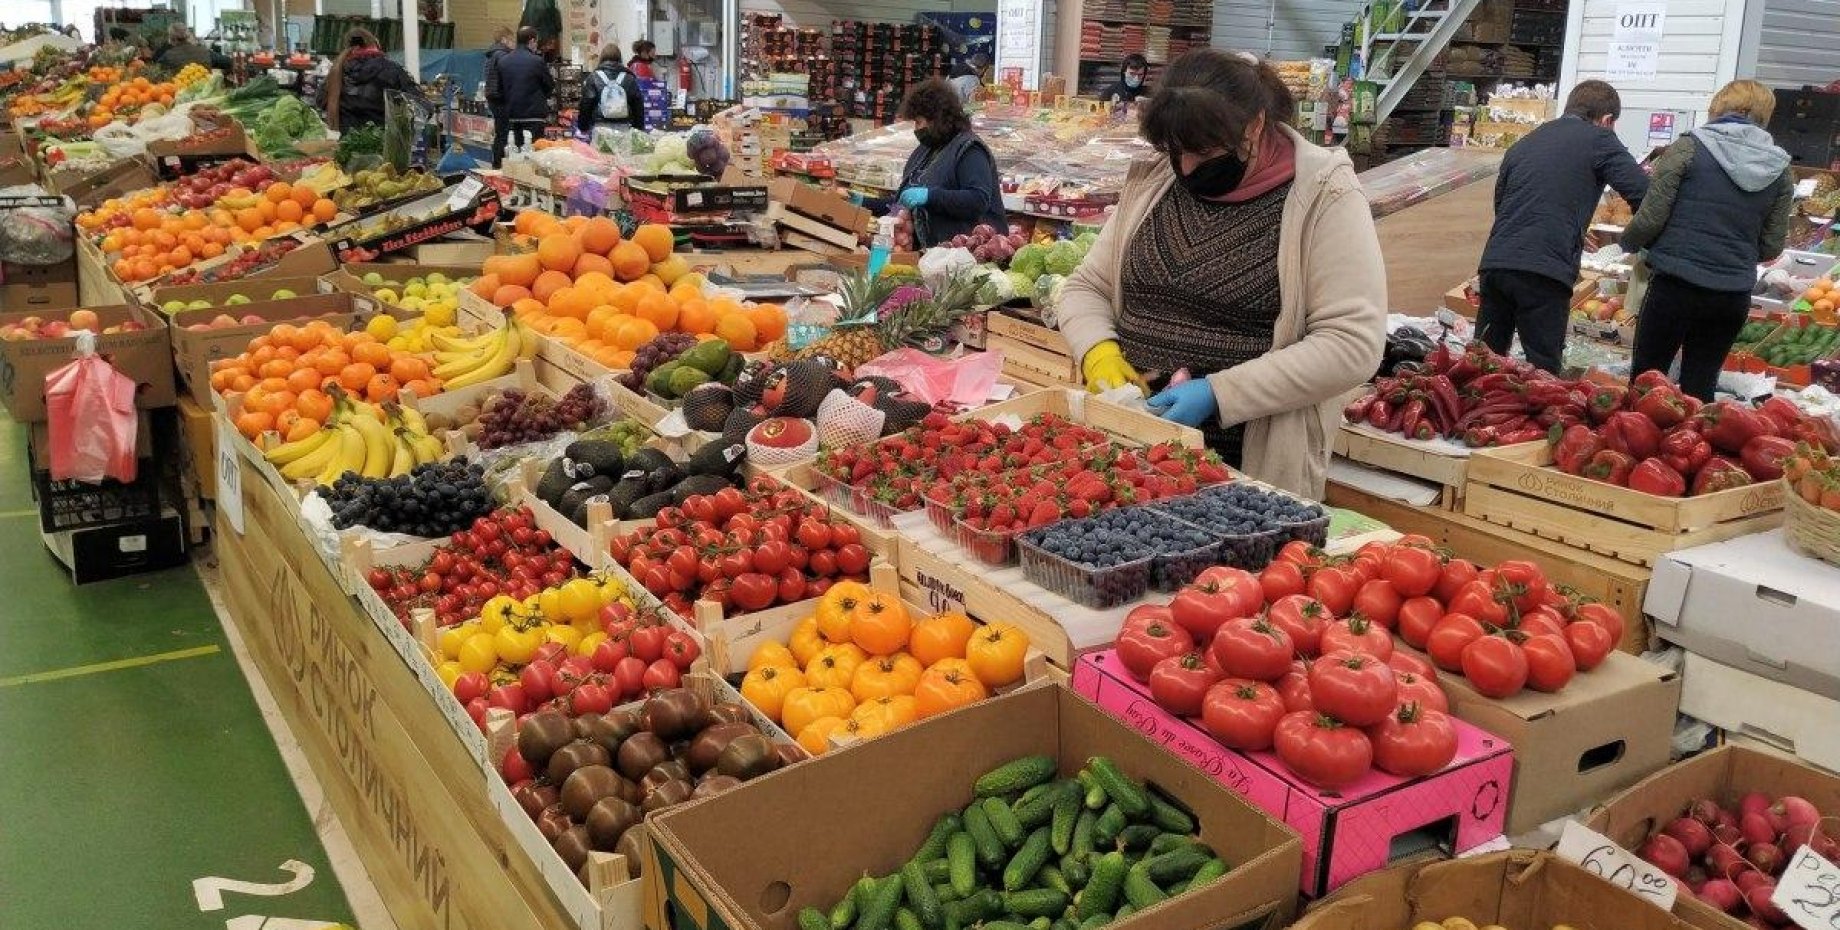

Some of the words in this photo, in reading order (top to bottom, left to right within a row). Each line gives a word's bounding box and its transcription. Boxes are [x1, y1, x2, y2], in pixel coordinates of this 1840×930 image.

[1621, 13, 1659, 28] ОПТ
[310, 601, 376, 740] РИНОК
[311, 662, 450, 928] СТОЛИЧНИЙ
